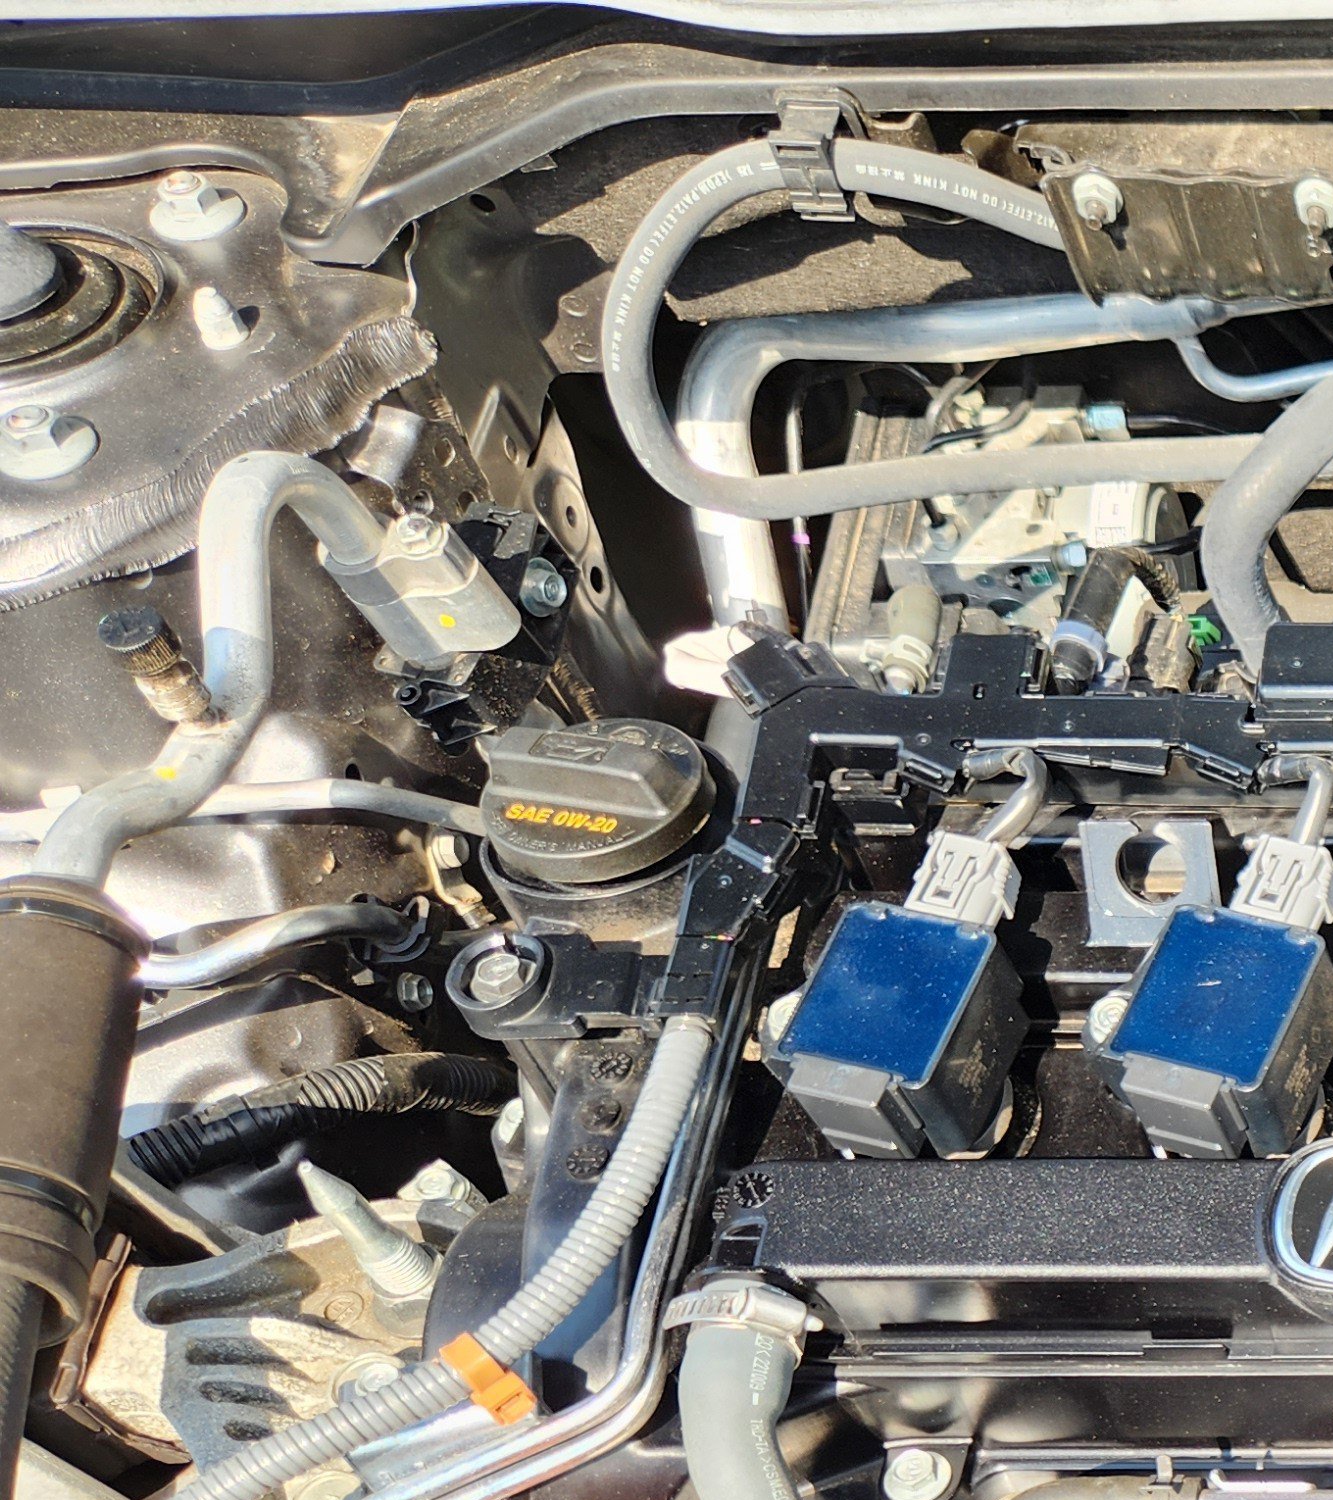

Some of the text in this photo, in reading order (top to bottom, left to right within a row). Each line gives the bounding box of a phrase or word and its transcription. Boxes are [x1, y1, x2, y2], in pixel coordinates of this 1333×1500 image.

[913, 172, 948, 191] KINK
[951, 182, 977, 200] NOT
[626, 266, 645, 293] NOT
[614, 292, 633, 328] KINK
[505, 802, 555, 825] SAE
[552, 809, 619, 834] 0W-20
